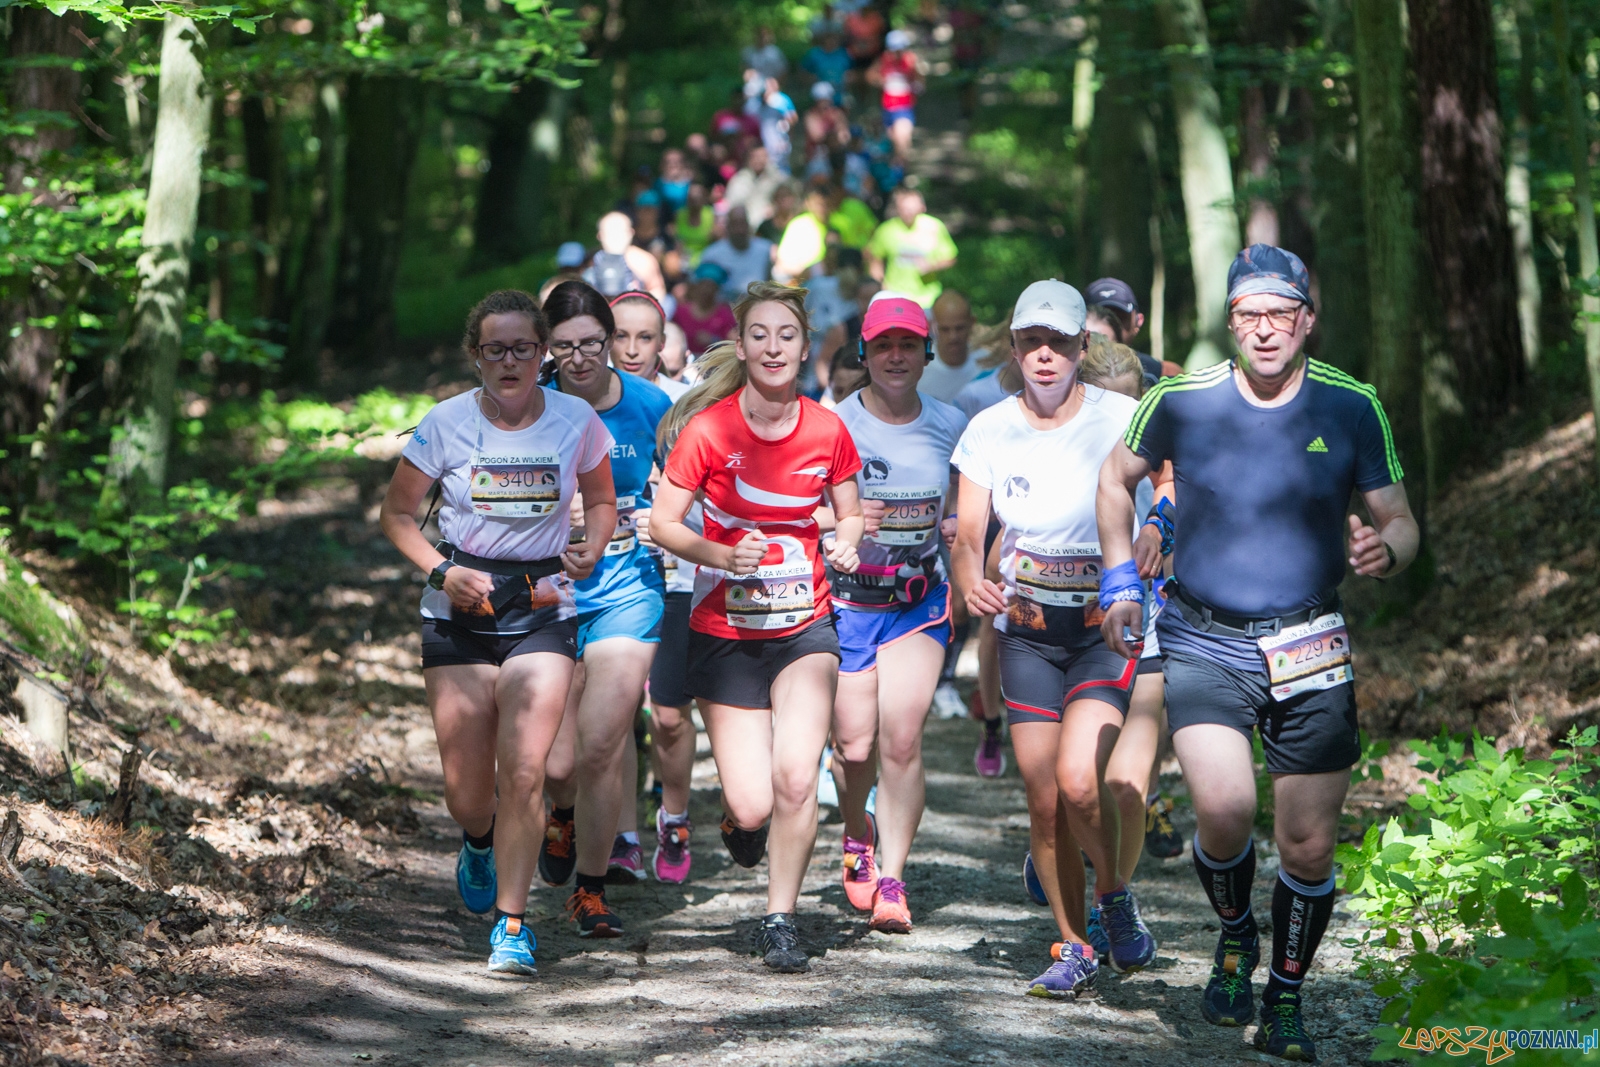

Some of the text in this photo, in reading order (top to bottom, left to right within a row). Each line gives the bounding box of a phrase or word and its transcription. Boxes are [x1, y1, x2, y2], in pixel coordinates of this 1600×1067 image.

[510, 456, 520, 464] ZA
[522, 456, 554, 464] WILKIEM
[498, 470, 534, 488] 340
[911, 490, 938, 498] WILKIEM
[887, 503, 920, 519] 205
[775, 567, 806, 576] WILKIEM
[1039, 560, 1075, 578] 249
[752, 582, 788, 600] 342
[1309, 619, 1337, 633] WILKIEM
[1292, 639, 1323, 665] 229
